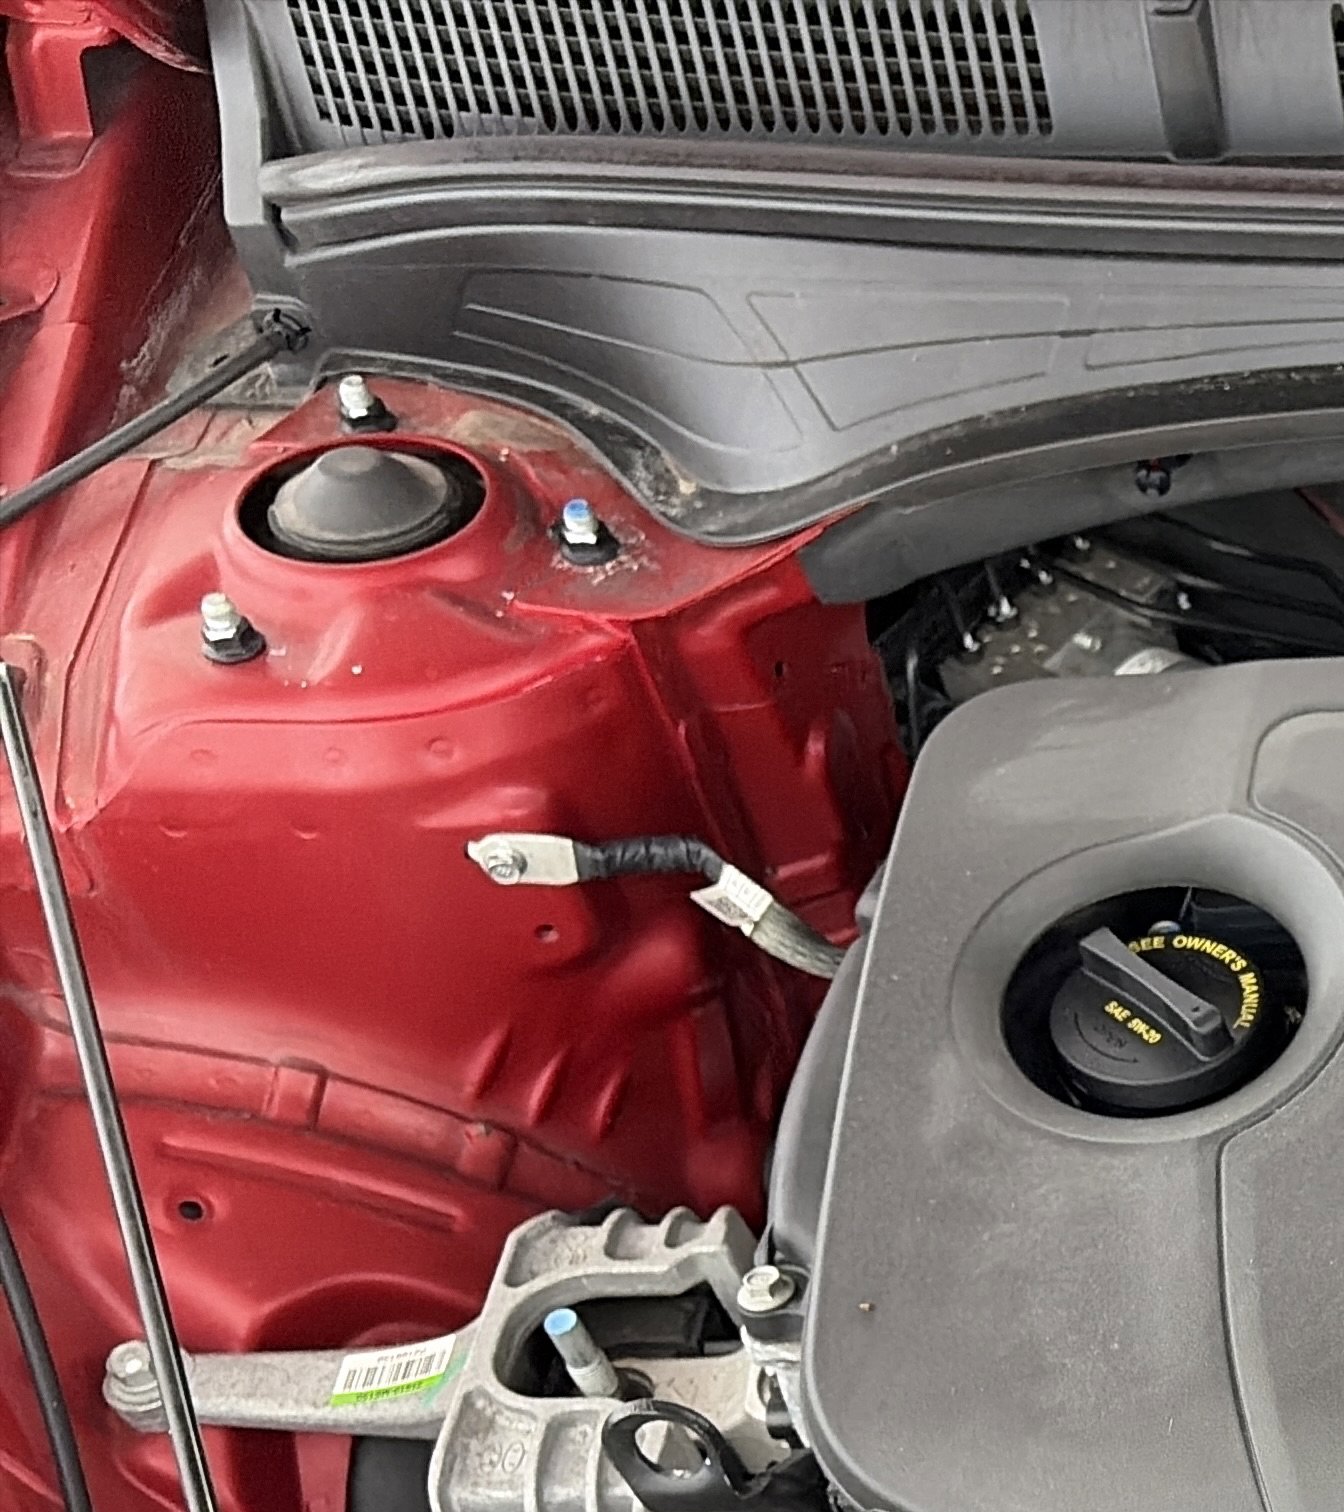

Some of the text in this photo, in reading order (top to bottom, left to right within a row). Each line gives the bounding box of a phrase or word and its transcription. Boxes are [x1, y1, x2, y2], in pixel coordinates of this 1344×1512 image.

[1127, 934, 1260, 1030] SEE OWNER'S MANUAL
[1103, 1000, 1132, 1022] SAE
[1126, 1017, 1162, 1044] 5W-20
